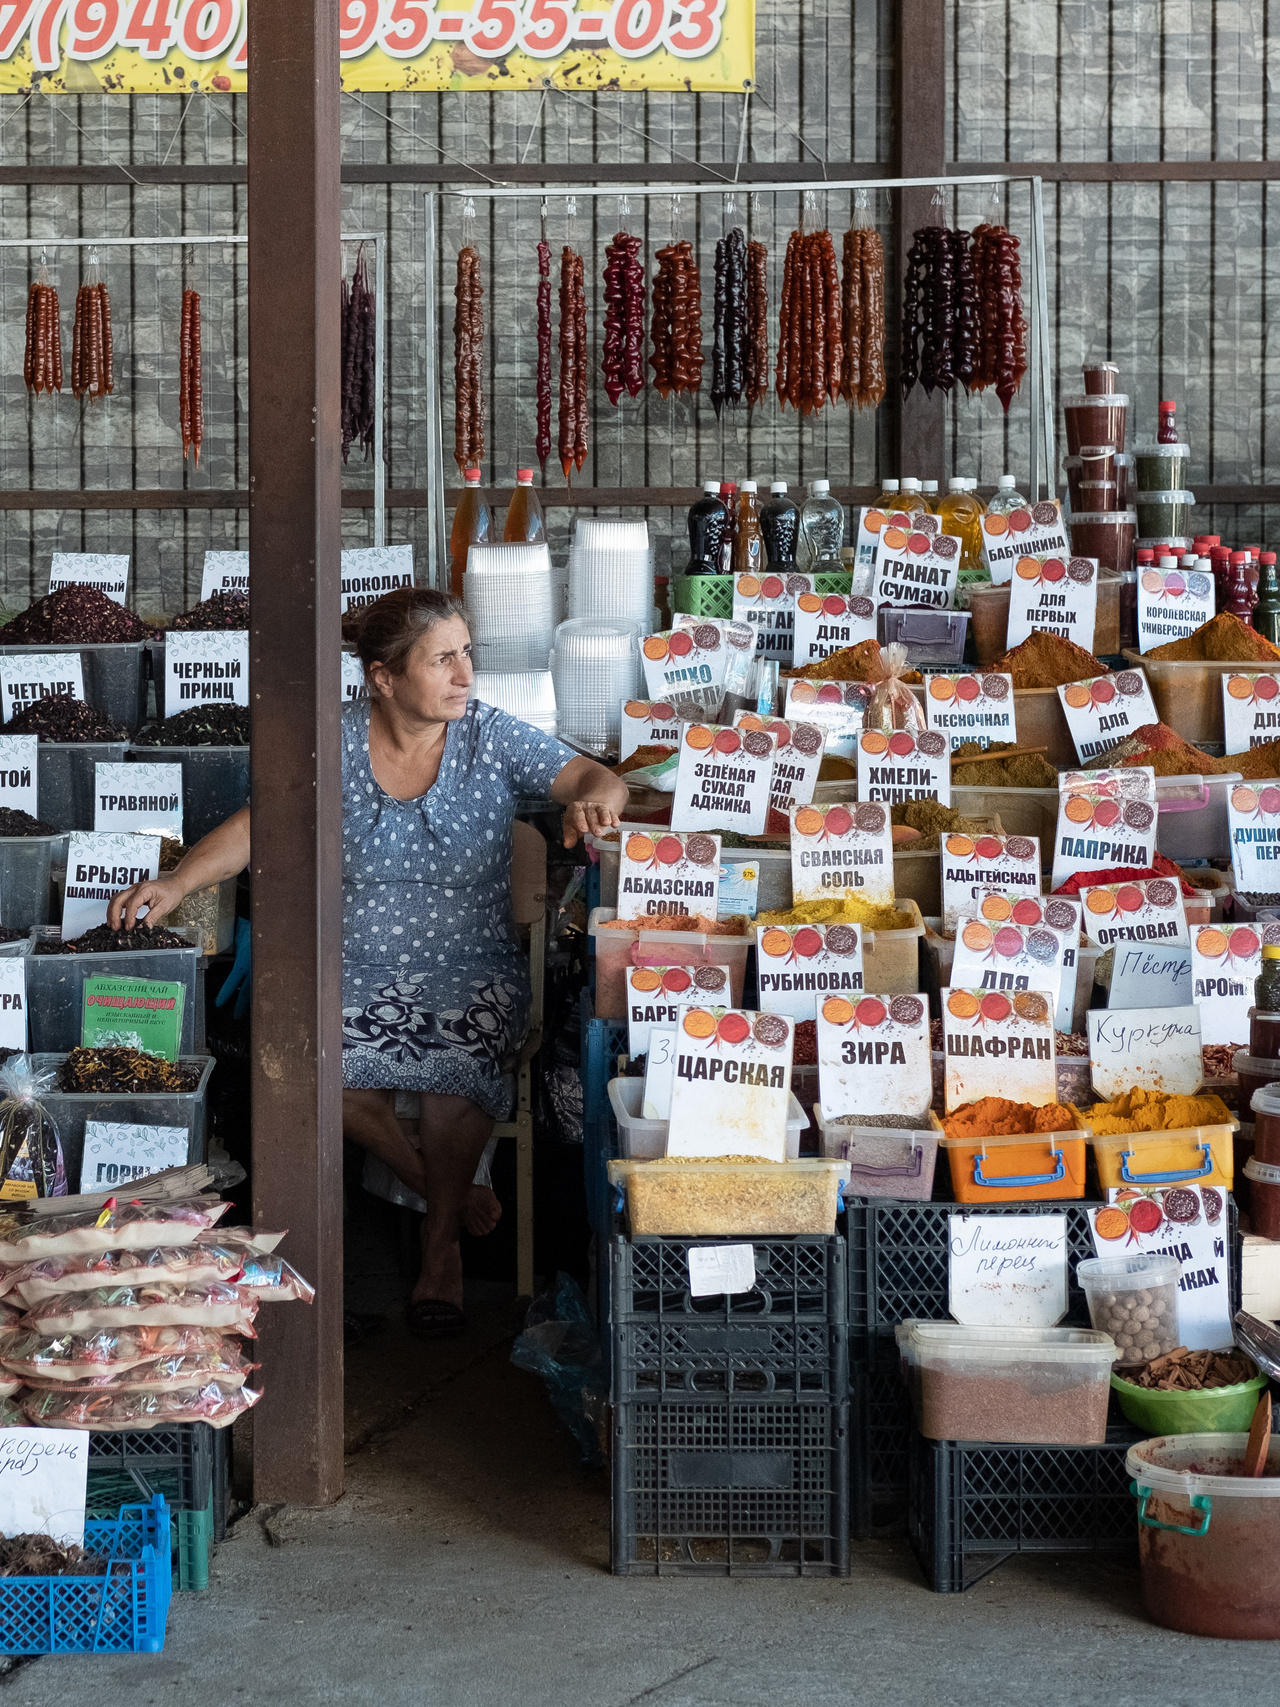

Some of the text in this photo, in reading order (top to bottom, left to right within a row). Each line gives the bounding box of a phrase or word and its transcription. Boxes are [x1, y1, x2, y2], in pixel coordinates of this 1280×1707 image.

[340, 0, 720, 57] 95-55-03
[988, 536, 1065, 562] БАБУШКИНА
[883, 559, 950, 587] ГРАНАТ
[341, 574, 412, 594] ШОКОЛАД
[1039, 594, 1066, 607] ДЛЯ
[1027, 609, 1077, 624] ПЕРВЫХ
[1147, 606, 1206, 622] КОРОЛЕВСКАЯ
[816, 625, 850, 641] ДЛЯ
[1031, 625, 1070, 640] БЛЮД
[173, 658, 241, 679] ЧЕРНЫЙ
[7, 681, 76, 700] ЧЕТЫРЕ
[180, 682, 234, 701] ПРИНЦ
[933, 712, 1010, 728] ЧЕСНОЧНАЯ
[1099, 711, 1130, 733] ДЛЯ
[1254, 712, 1280, 730] ДЛ
[651, 728, 678, 741] ДЛЯ
[951, 736, 993, 750] СМЕСЬ
[694, 763, 756, 784] ЗЕЛЁНАЯ
[869, 766, 938, 786] ХМЕЛИ-
[701, 780, 745, 798] СУХАЯ
[869, 787, 938, 804] СУНЕЛИ
[99, 793, 179, 811] ТРАВЯНОЙ
[690, 794, 751, 815] АДЖИКА
[800, 848, 884, 868] СВАНСКАЯ
[1061, 837, 1147, 865] ПАПРИКА
[75, 864, 150, 885] БРЫЗГИ
[821, 871, 865, 888] СОЛЬ
[946, 868, 1036, 886] АДЫГЕЙСКАЯ
[623, 877, 715, 898] АБХАЗСКАЯ
[647, 900, 689, 916] СОЛЬ
[1098, 921, 1178, 945] ОРЕХОВАЯ
[94, 983, 168, 994] АБХАЗСКИЙ ЧАЙ
[760, 972, 863, 992] РУБИНОВАЯ
[979, 970, 1029, 990] ДЛЯ
[86, 994, 176, 1011] ОЧИЩАЮЩИЙ
[1096, 1014, 1202, 1053] Куркума
[841, 1041, 907, 1065] ЗИРА
[947, 1033, 1051, 1060] ШАФРАН
[677, 1054, 785, 1089] ЦАРСКАЯ
[951, 1226, 1066, 1257] Лимонный
[976, 1254, 1036, 1276] перец
